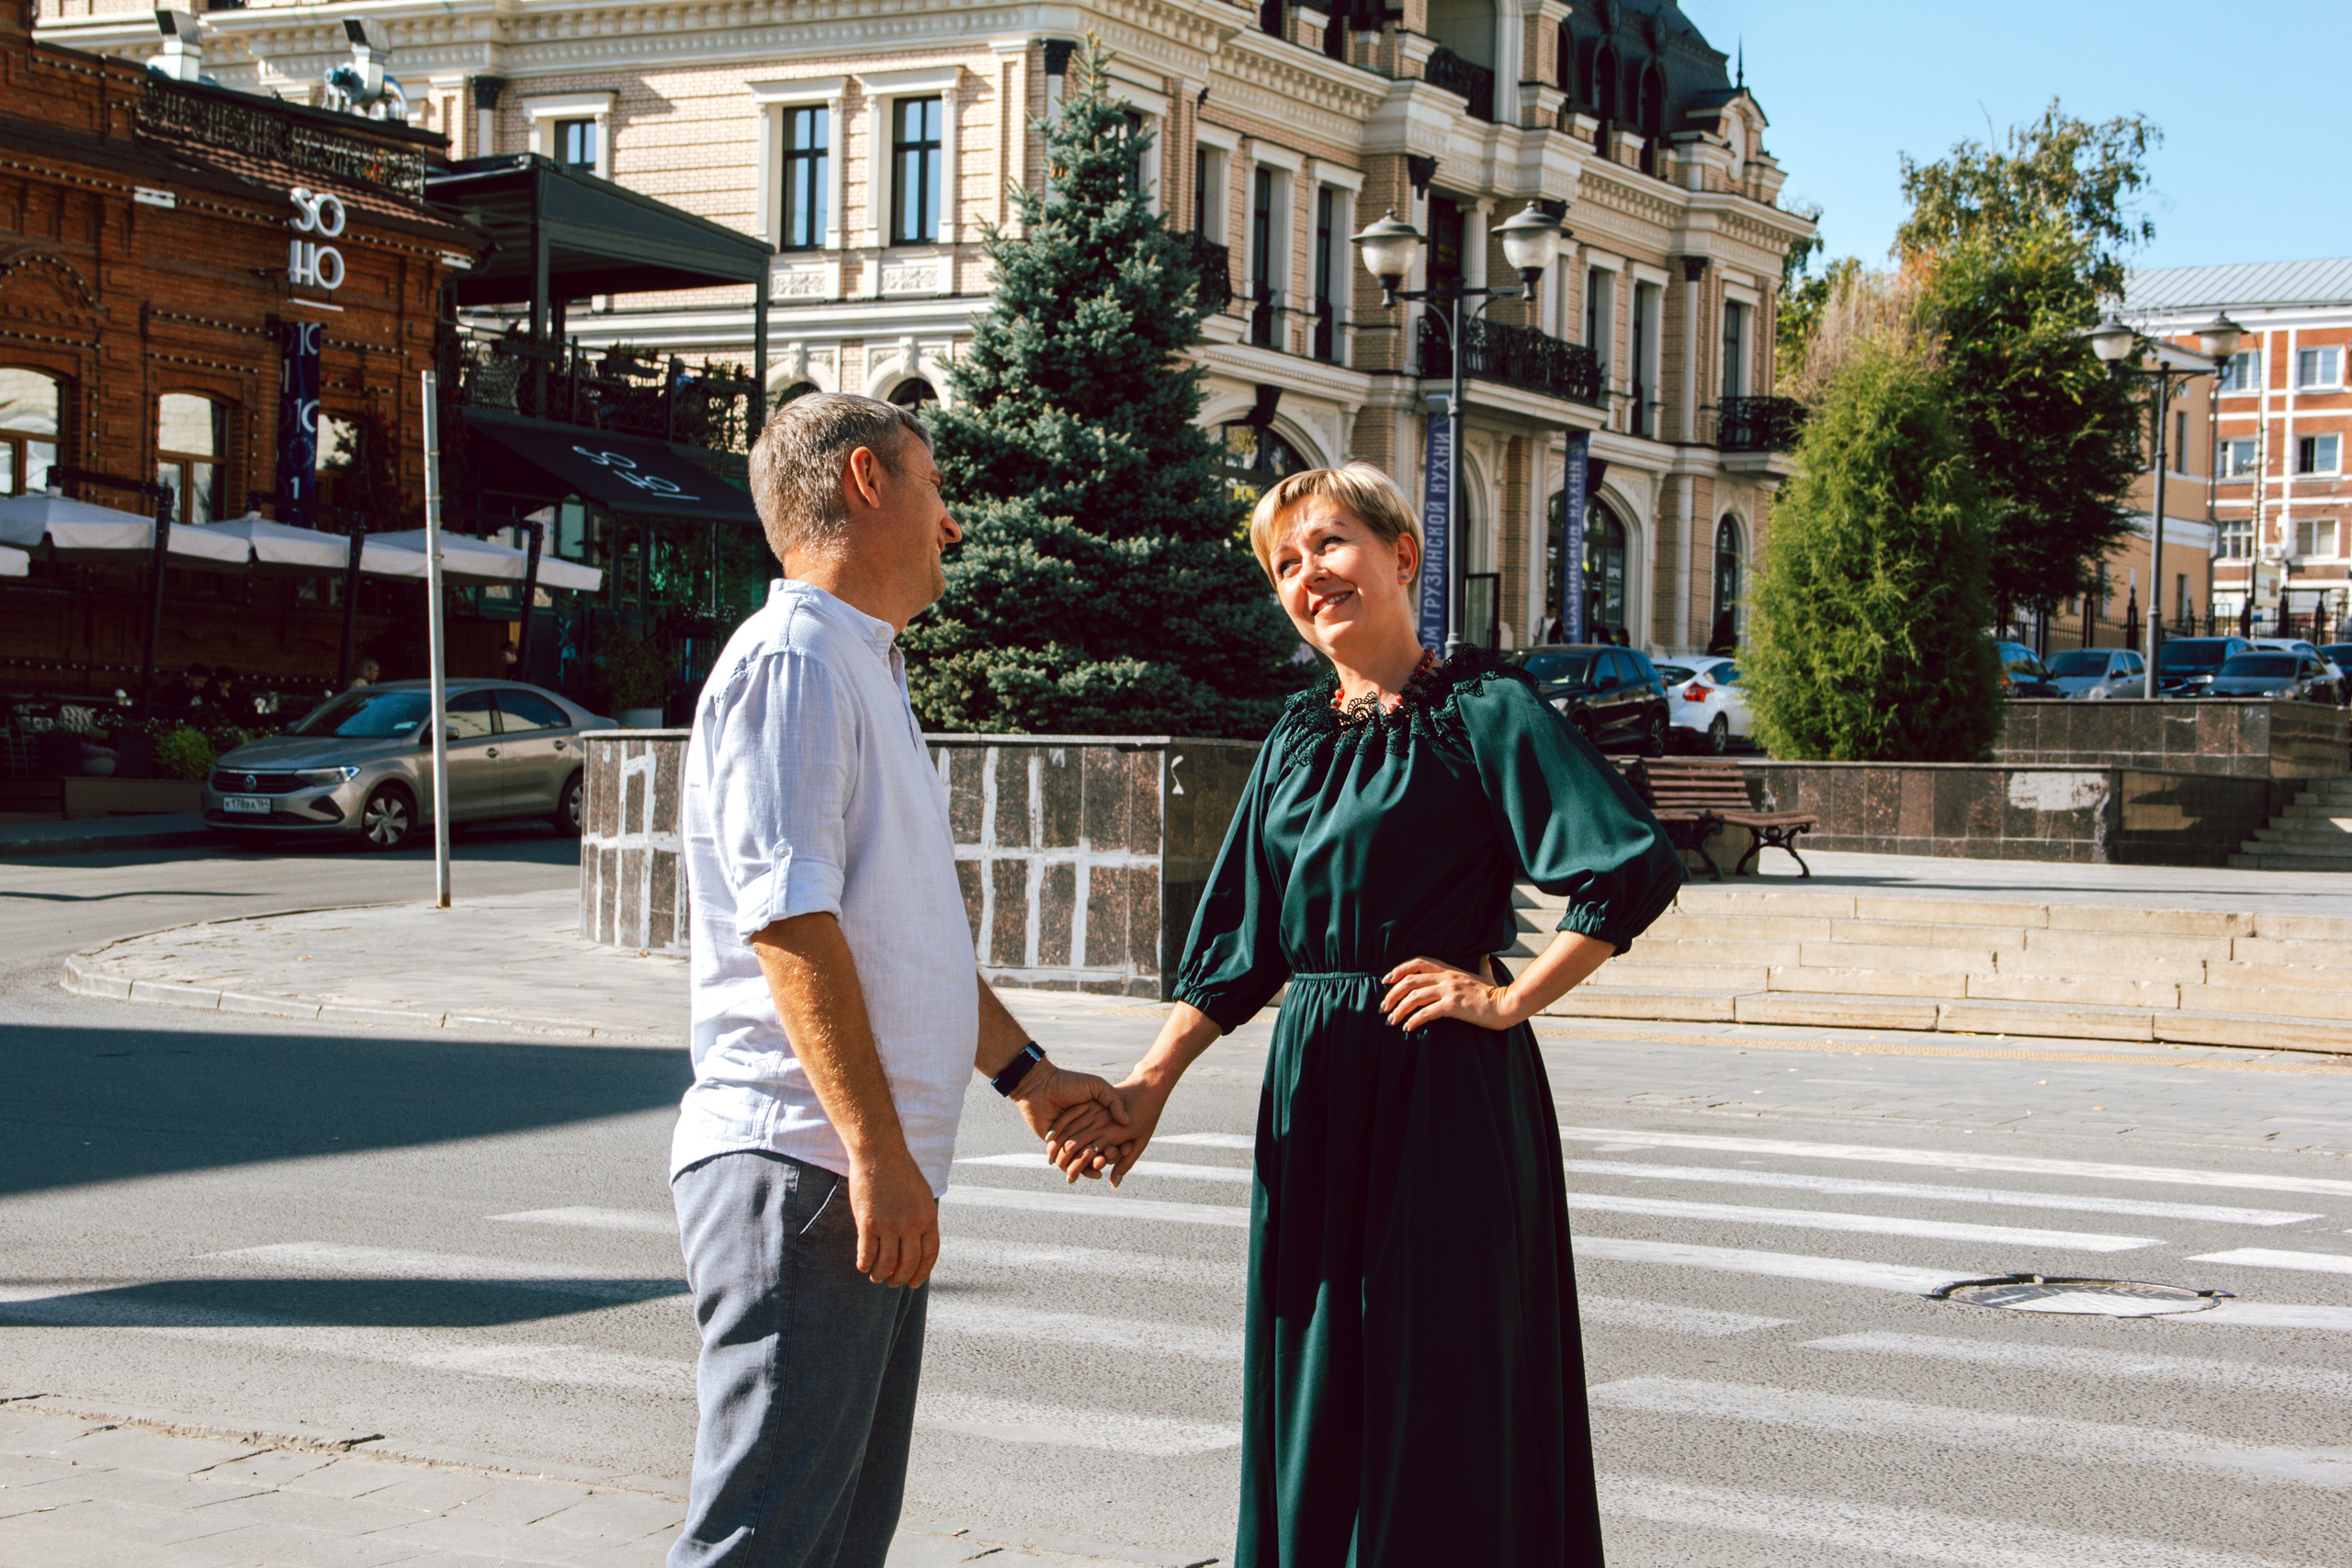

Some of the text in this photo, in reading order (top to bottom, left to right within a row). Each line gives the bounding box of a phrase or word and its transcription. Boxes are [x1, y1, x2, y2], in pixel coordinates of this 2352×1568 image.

[289, 186, 345, 237] SO
[288, 240, 345, 289] HO
[571, 446, 637, 468] SO
[1422, 433, 1450, 660] ОМ ГРУЗИНСКОЙ КУХНИ
